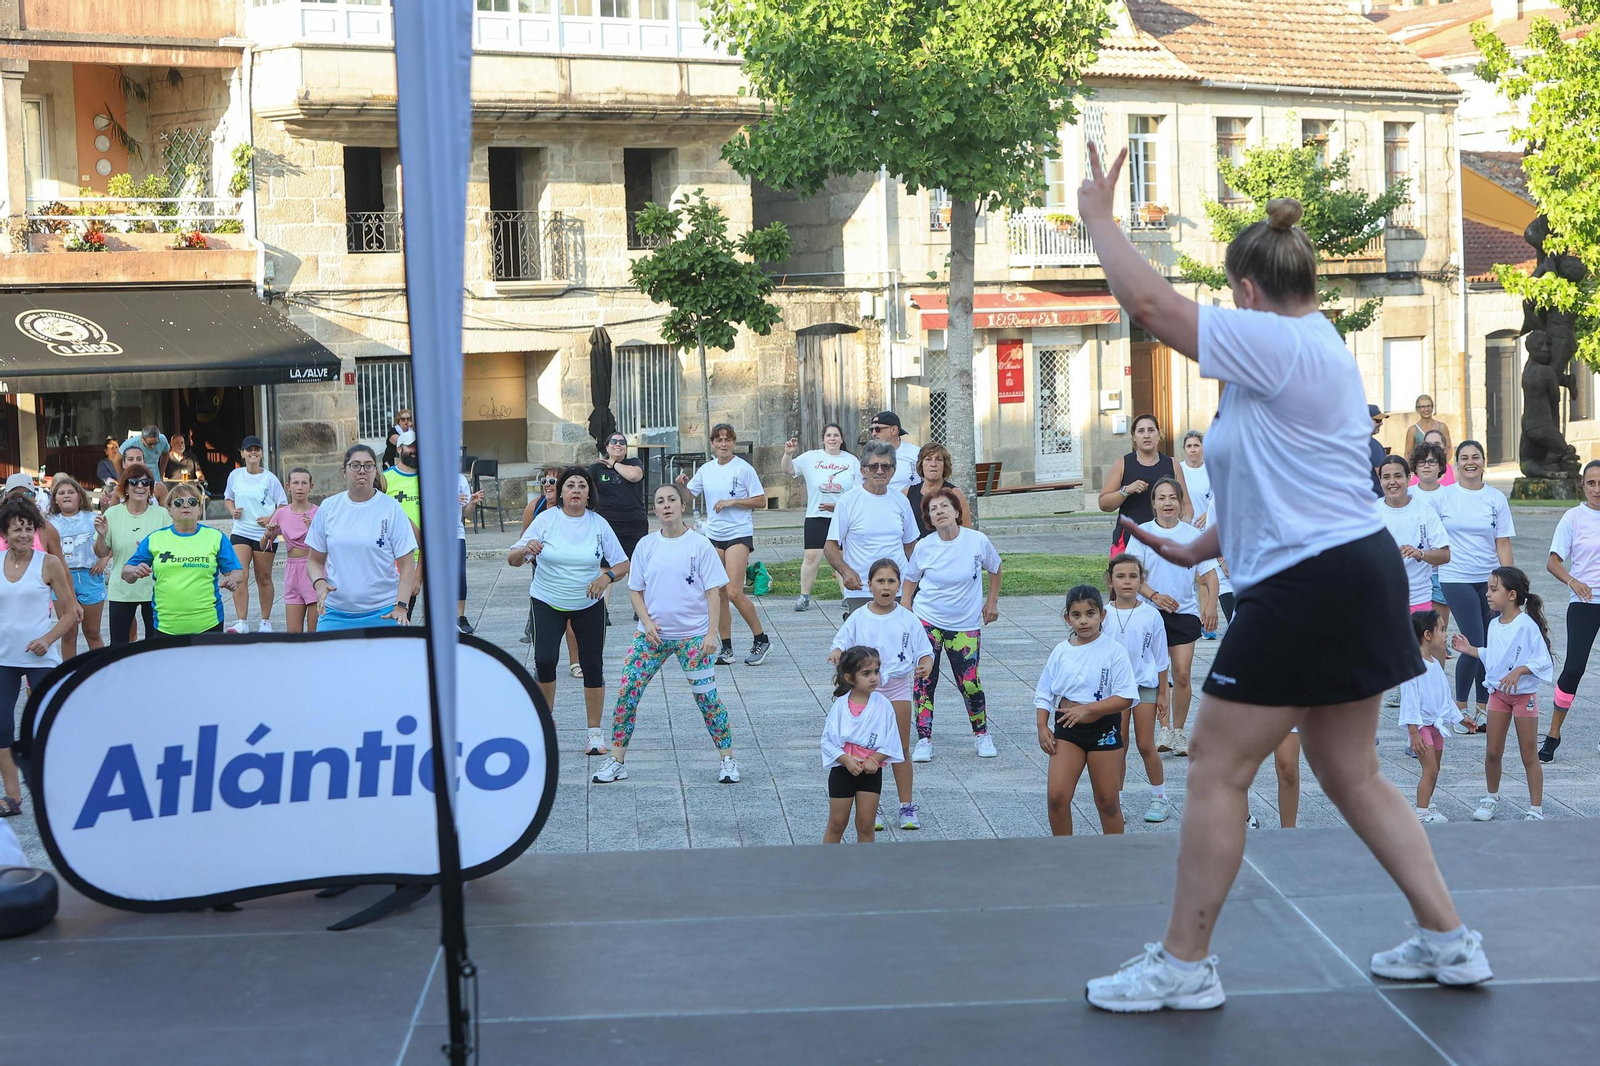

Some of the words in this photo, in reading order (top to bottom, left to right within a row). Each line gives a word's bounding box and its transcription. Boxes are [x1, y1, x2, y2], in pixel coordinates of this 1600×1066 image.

[58, 345, 73, 354] O
[72, 343, 114, 353] CUCO
[289, 368, 301, 378] LA
[302, 368, 328, 378] SALVE
